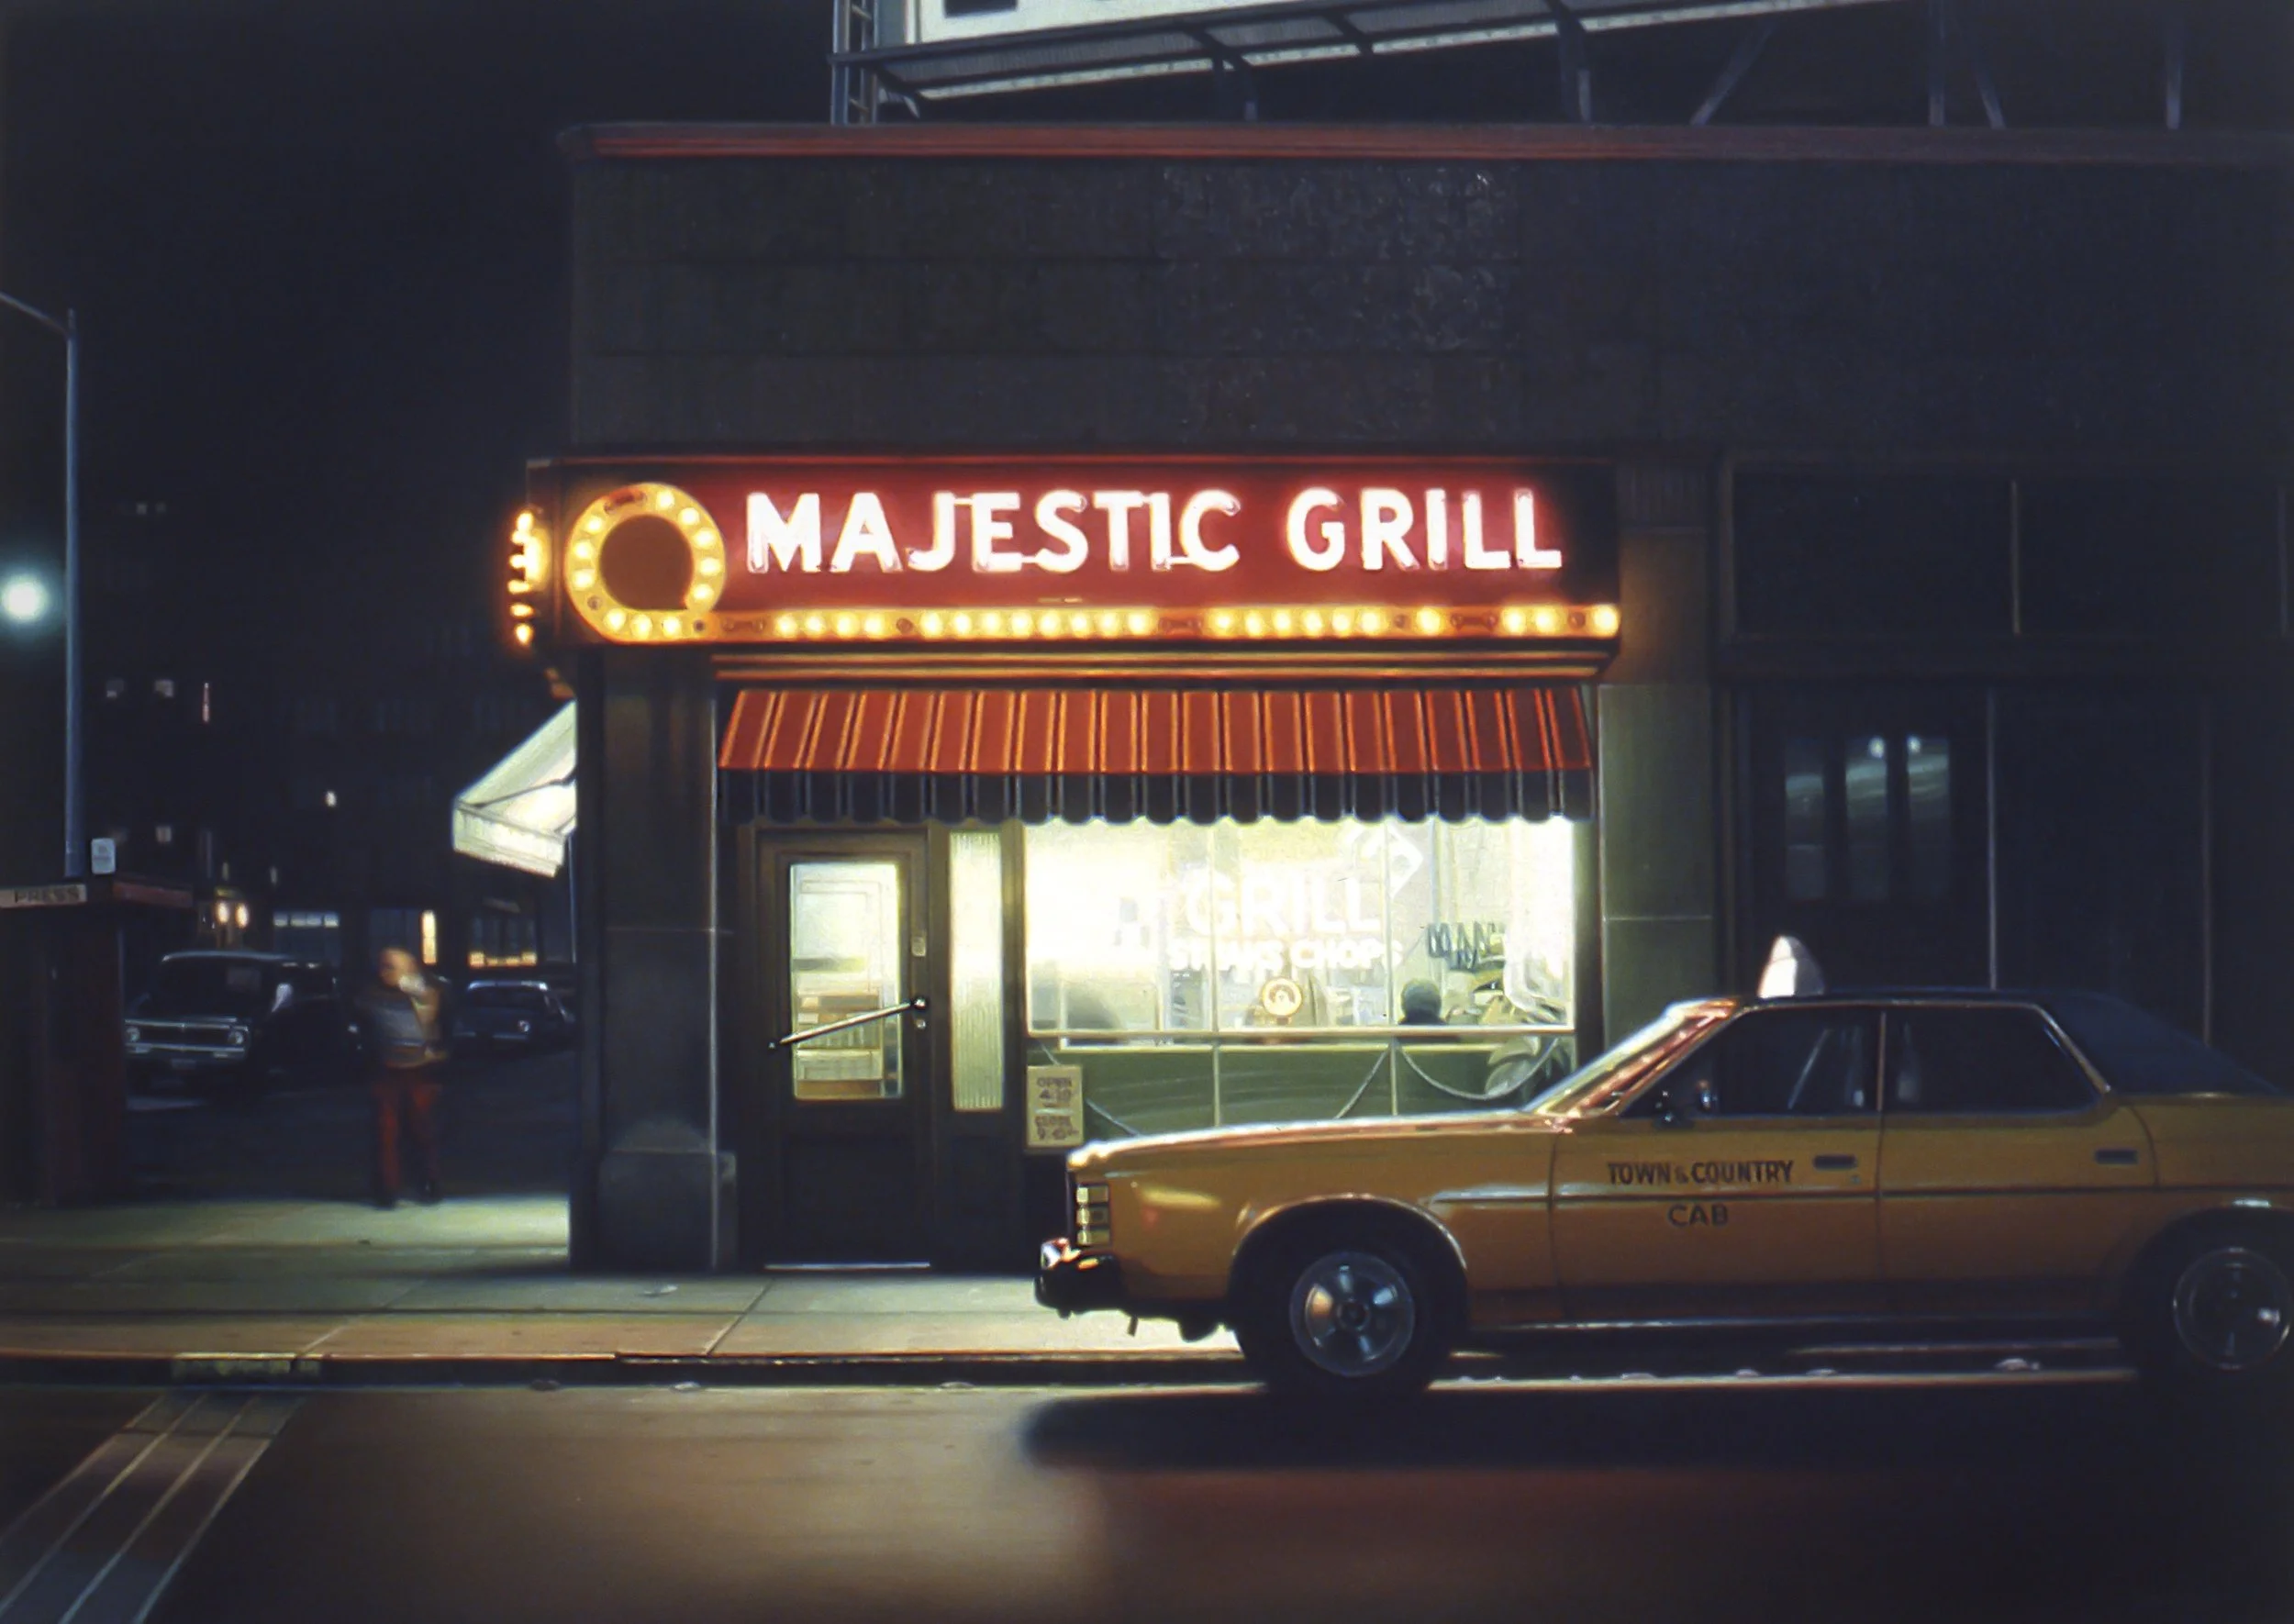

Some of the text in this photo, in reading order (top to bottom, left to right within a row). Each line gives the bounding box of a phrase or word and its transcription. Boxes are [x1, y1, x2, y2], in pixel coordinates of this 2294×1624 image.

[746, 486, 1562, 573] MAJESTIC GRILL
[14, 884, 81, 904] PRESS
[1185, 870, 1382, 937] GRILL
[1289, 937, 1404, 970] CHOPS
[1608, 1162, 1671, 1185] TOWN
[1691, 1160, 1794, 1184] COUNTRY
[1667, 1204, 1729, 1228] CAB
